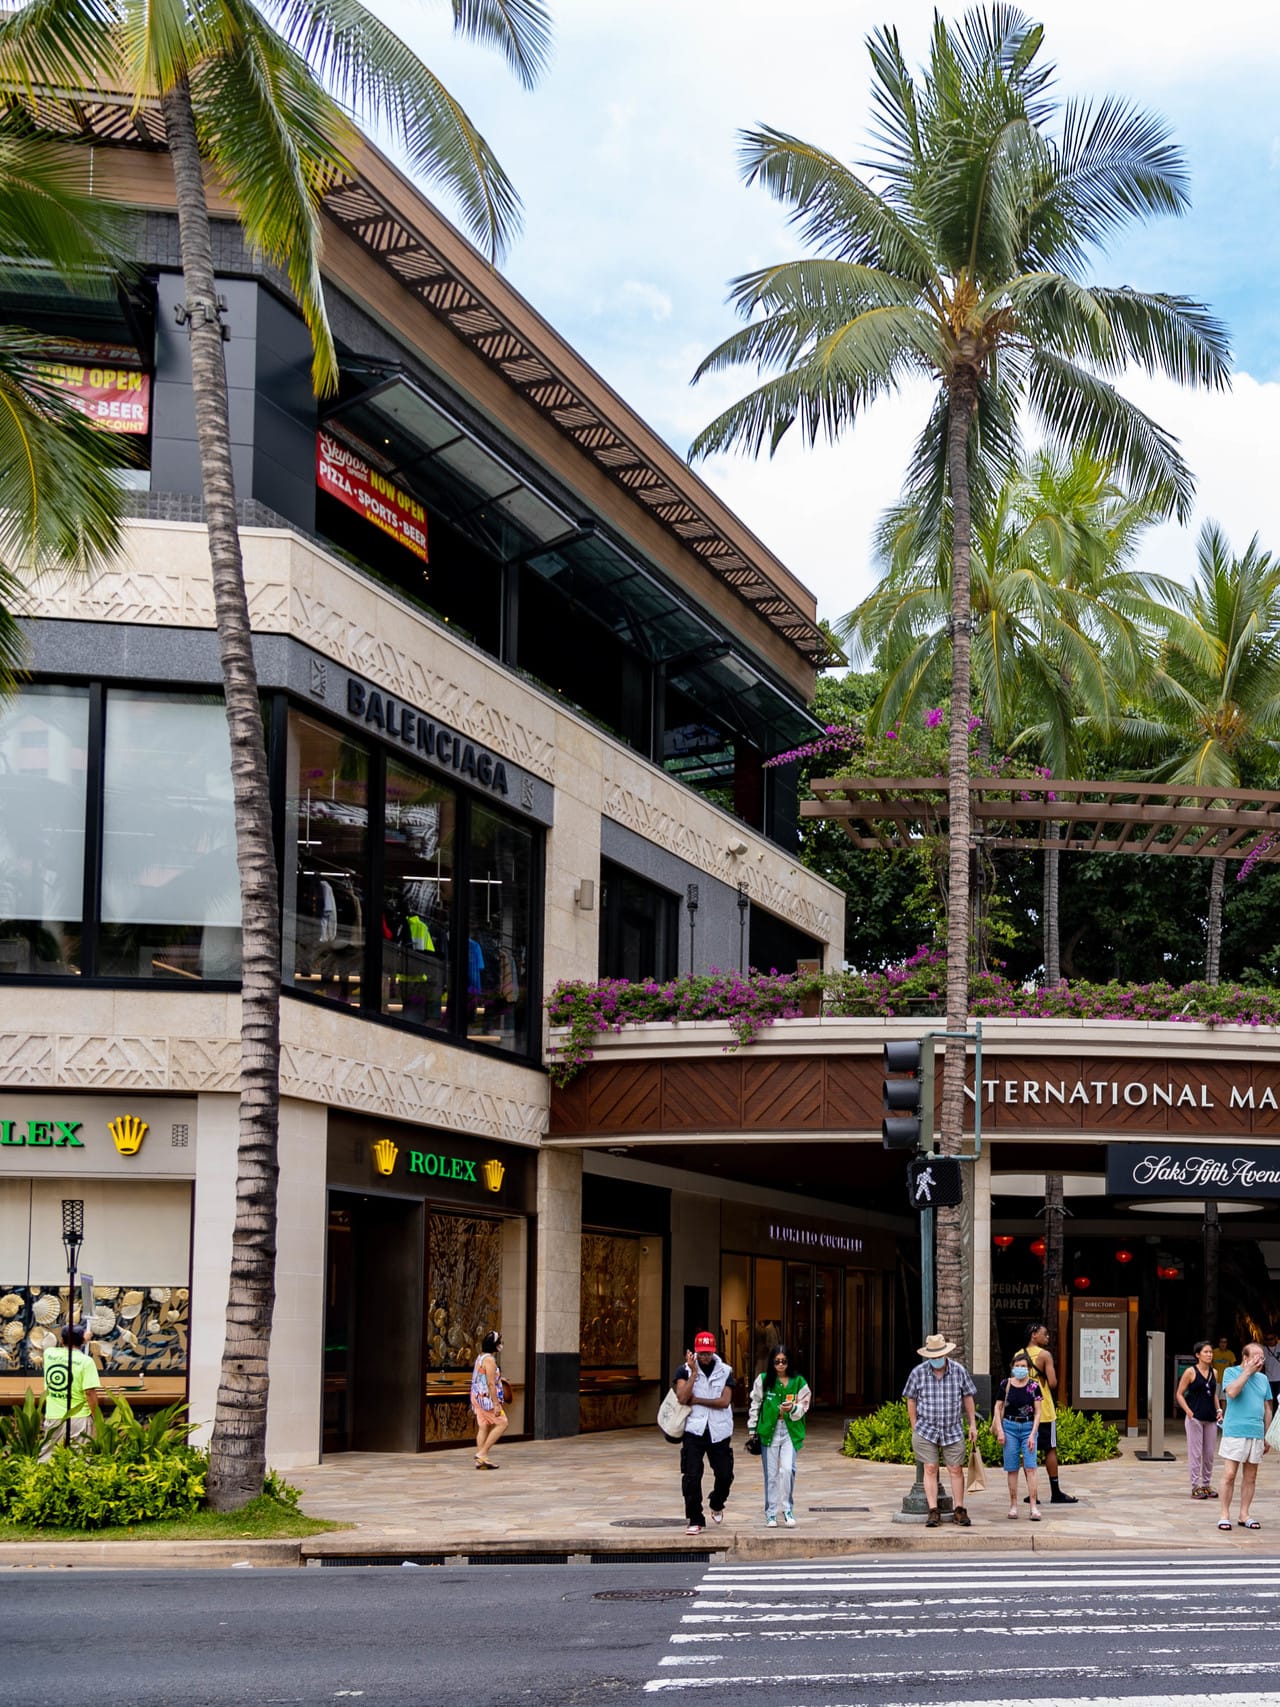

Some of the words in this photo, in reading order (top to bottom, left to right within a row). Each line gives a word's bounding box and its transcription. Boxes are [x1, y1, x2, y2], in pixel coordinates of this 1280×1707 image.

[37, 365, 85, 387] NOW
[89, 368, 142, 392] OPEN
[92, 418, 144, 431] ISCOUNT
[97, 400, 144, 419] BEER
[319, 432, 369, 473] Skybox
[319, 460, 353, 496] PIZZA
[358, 488, 399, 528] SPORTS
[403, 520, 427, 549] BEER
[370, 469, 396, 503] NOW
[397, 492, 425, 523] OPEN
[347, 678, 509, 795] BALENCIAGA
[963, 1080, 1215, 1107] NTERNATIONAL
[0, 1119, 84, 1147] LEX
[409, 1150, 477, 1182] ROLEX
[1133, 1155, 1187, 1184] Saks
[1179, 1156, 1230, 1186] Fifth
